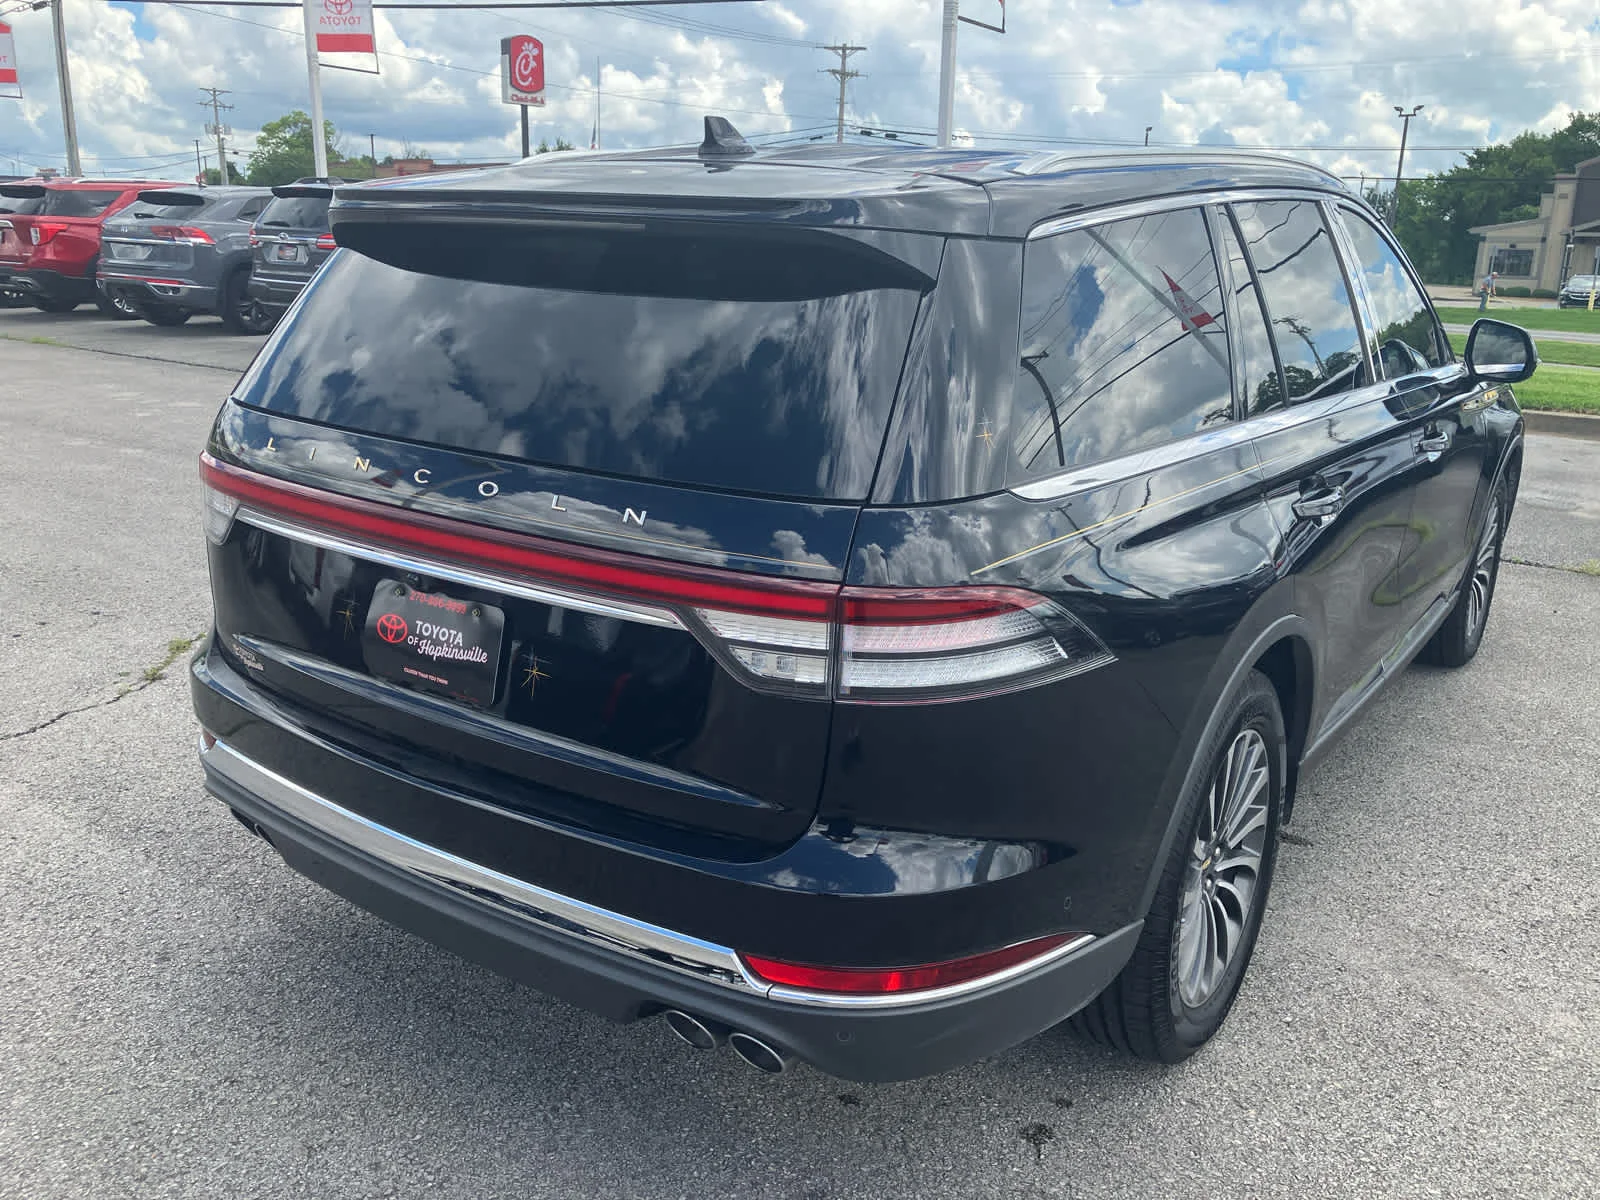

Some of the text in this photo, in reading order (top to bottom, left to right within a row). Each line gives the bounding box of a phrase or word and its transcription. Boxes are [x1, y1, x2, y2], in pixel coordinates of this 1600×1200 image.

[267, 437, 647, 527] LINCOLN
[416, 620, 463, 647] TOYOTA
[407, 635, 488, 663] OF Hopkinsville
